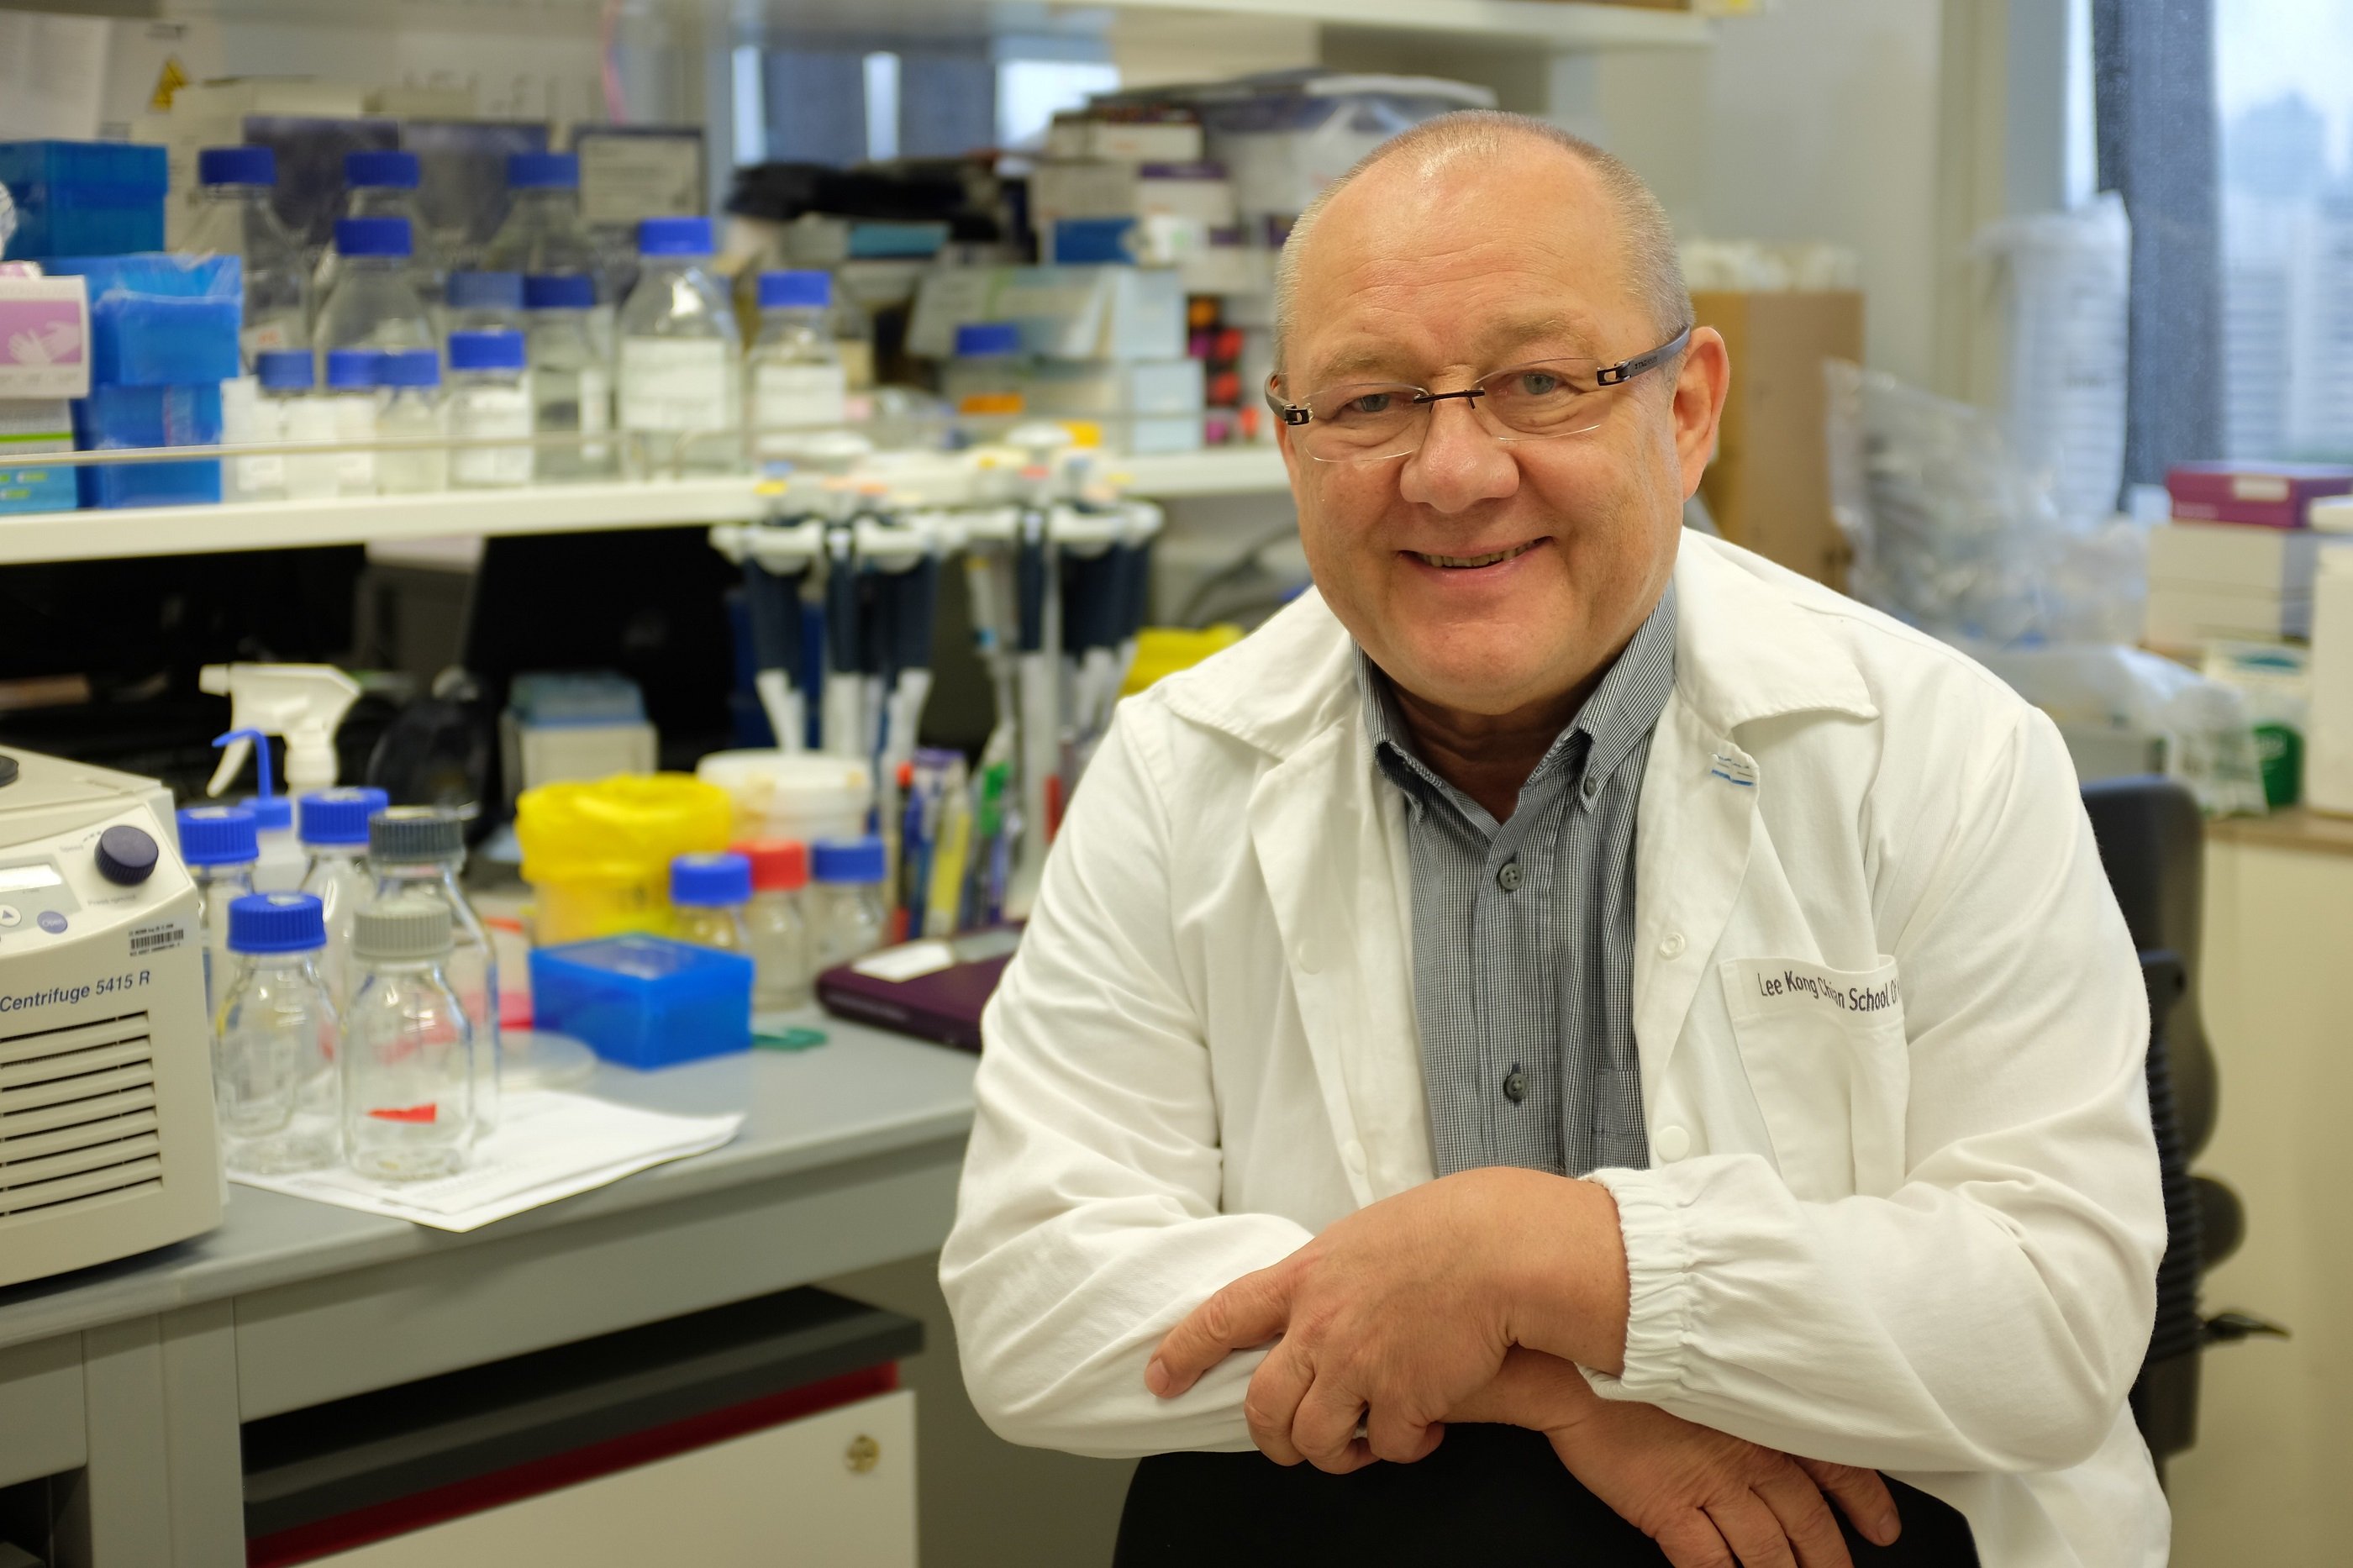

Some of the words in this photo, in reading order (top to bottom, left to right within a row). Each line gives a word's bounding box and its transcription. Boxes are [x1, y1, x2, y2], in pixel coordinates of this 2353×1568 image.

[0, 985, 91, 1013] Centrifuge
[95, 973, 134, 996] 5415
[139, 970, 150, 987] R
[1757, 972, 1783, 997] Lee
[1784, 970, 1819, 1000] Kong
[1849, 982, 1891, 1013] School
